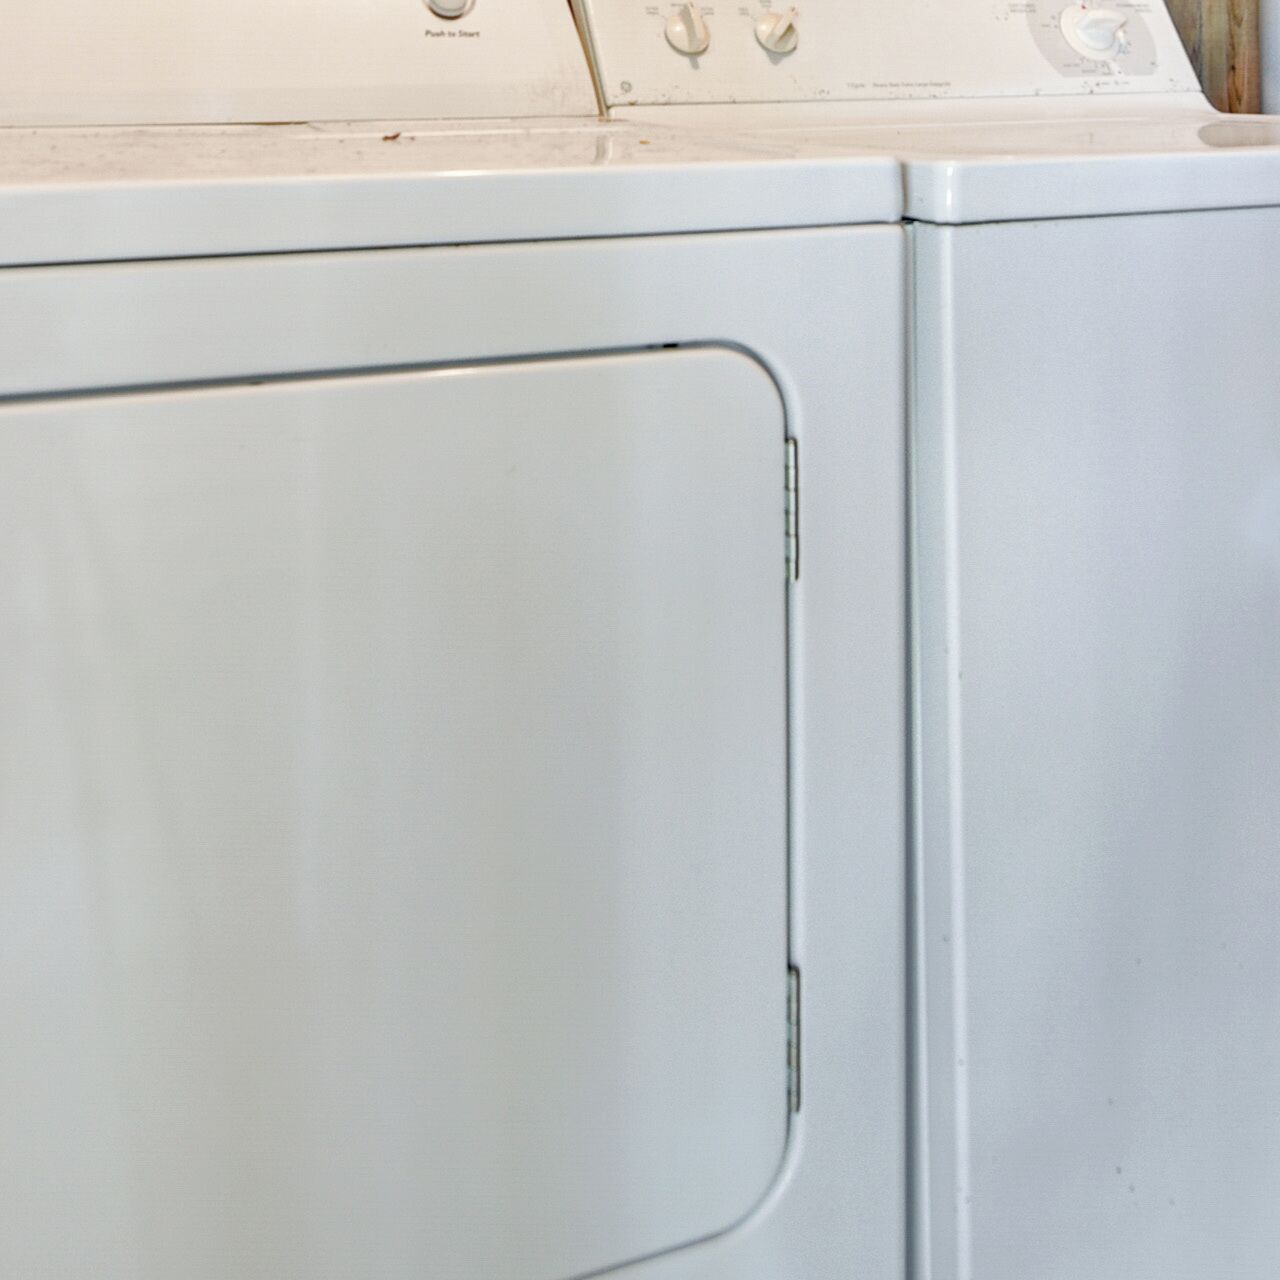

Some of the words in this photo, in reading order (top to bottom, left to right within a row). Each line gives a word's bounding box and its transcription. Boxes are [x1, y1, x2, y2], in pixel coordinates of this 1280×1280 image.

[425, 29, 446, 38] Push
[448, 30, 456, 38] to
[458, 29, 480, 38] Start
